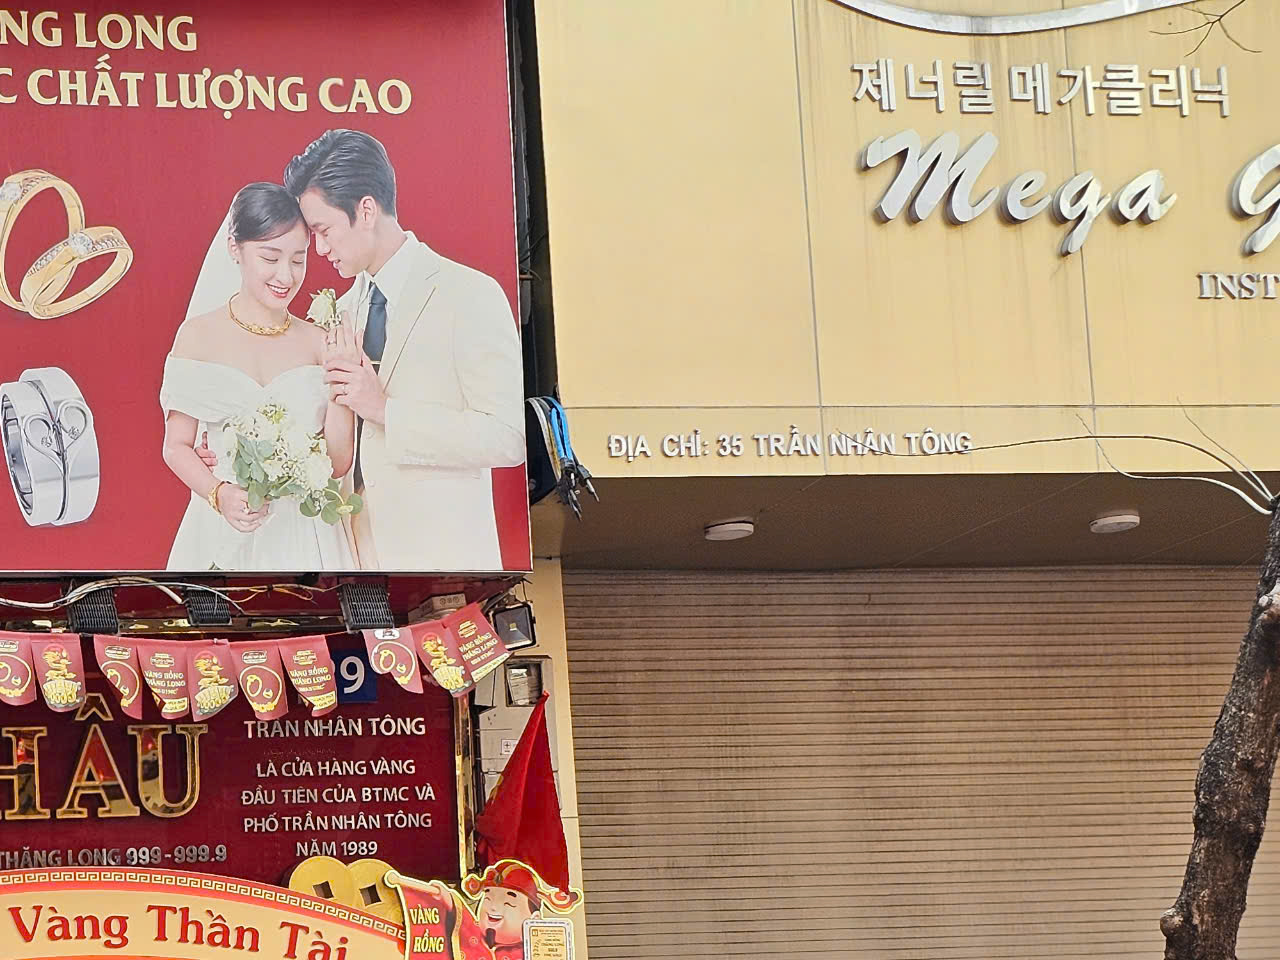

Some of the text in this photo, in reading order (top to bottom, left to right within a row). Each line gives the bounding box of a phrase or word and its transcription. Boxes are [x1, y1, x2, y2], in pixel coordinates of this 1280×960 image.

[74, 11, 198, 52] LONG
[26, 53, 145, 108] CHẤT
[154, 68, 308, 119] LƯỢNG
[318, 77, 412, 115] CAO
[859, 128, 1178, 257] Mega
[609, 432, 652, 463] ĐỊA
[718, 432, 744, 458] 35
[754, 424, 821, 457] TRẦN
[829, 427, 897, 457] NHÂN
[904, 426, 972, 456] TÔNG
[304, 715, 362, 737] NHÂN
[368, 714, 426, 736] TÔNG
[256, 756, 416, 778] LÀ CỬA HÀNG VÀNG
[241, 782, 436, 806] ĐẦU TIÊN CỦA BTMC VÀ
[244, 810, 433, 833] PHỐ TRẦN NHÂN TÔNG
[67, 848, 121, 867] LONG
[296, 839, 378, 857] NĂM 1989
[409, 904, 440, 925] VÀNG
[8, 904, 130, 949] Vàng
[147, 904, 260, 952] Thần
[413, 928, 445, 953] RỒNG
